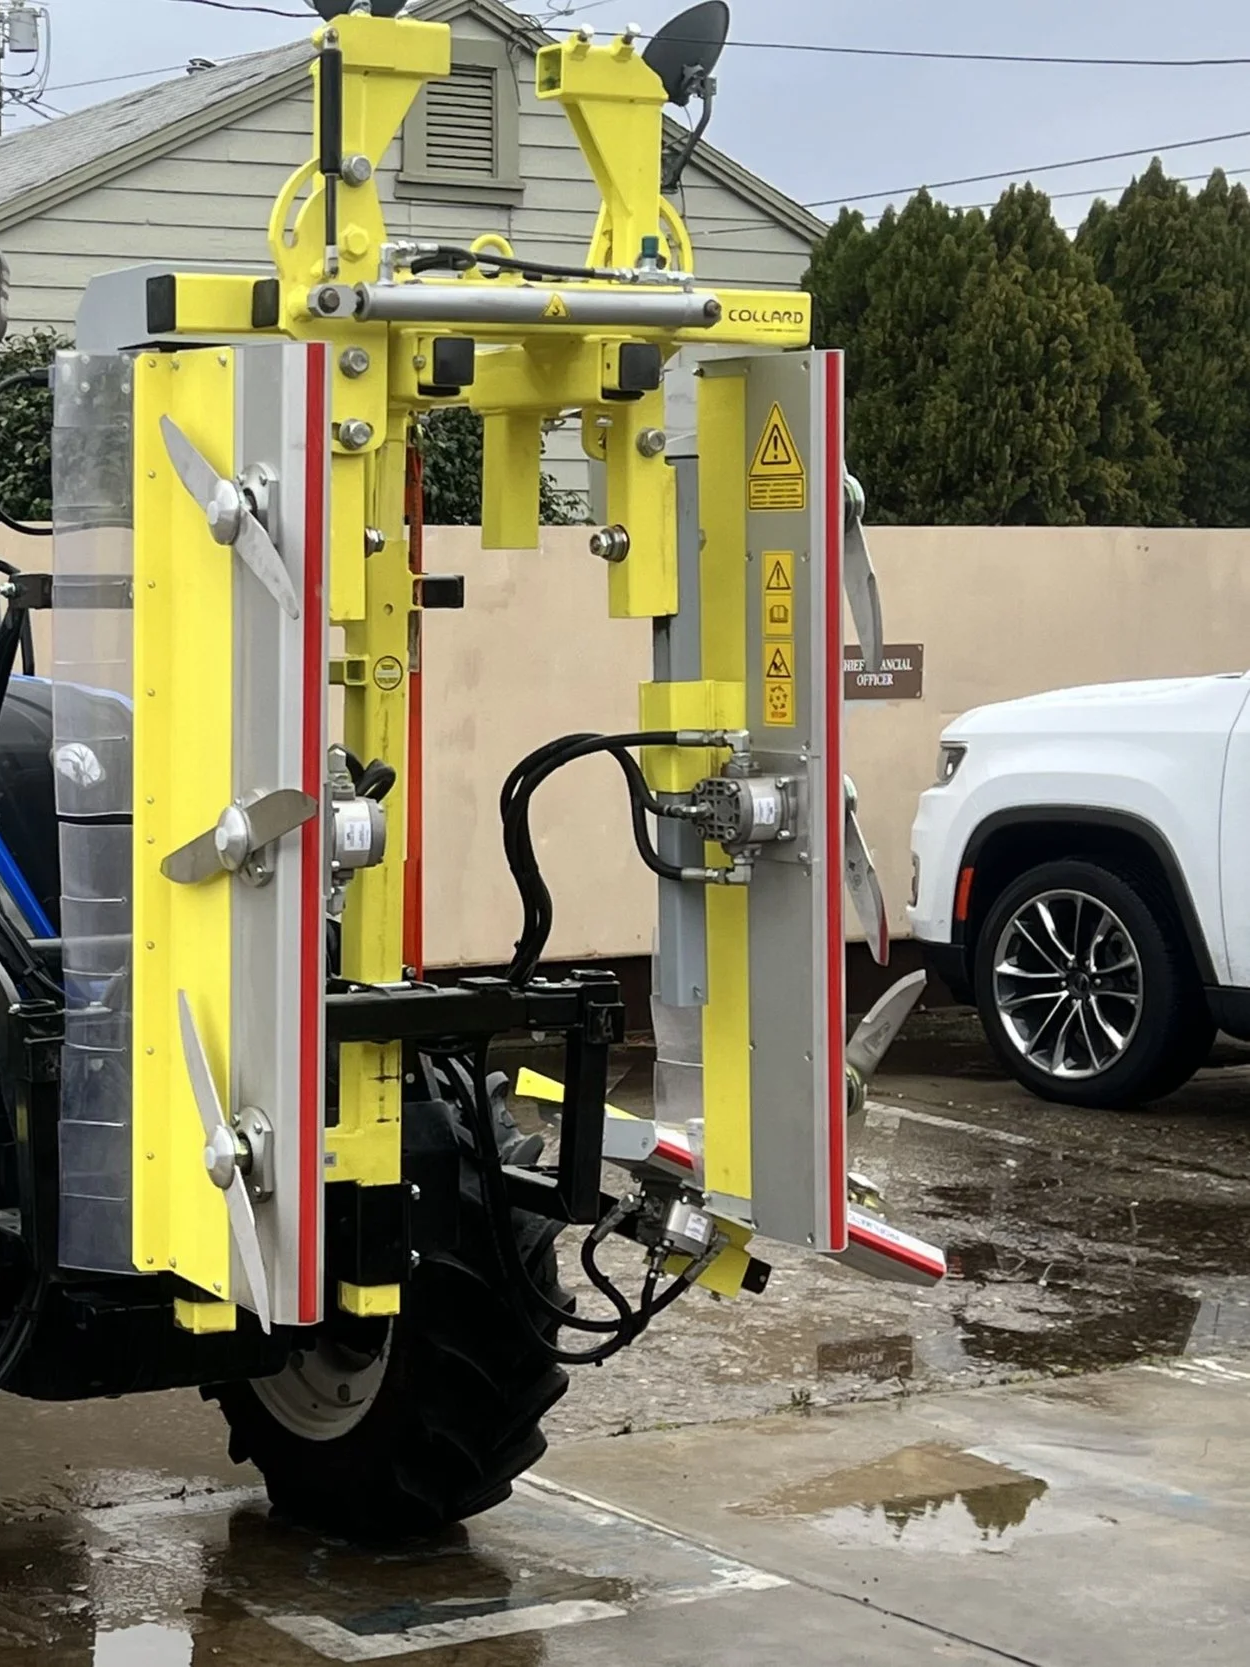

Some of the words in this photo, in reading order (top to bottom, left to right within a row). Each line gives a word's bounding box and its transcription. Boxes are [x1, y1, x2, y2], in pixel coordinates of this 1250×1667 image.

[728, 308, 804, 324] COLLARD
[843, 659, 865, 672] HIEF
[880, 657, 913, 671] ANCIAL
[856, 673, 894, 686] OFFICER
